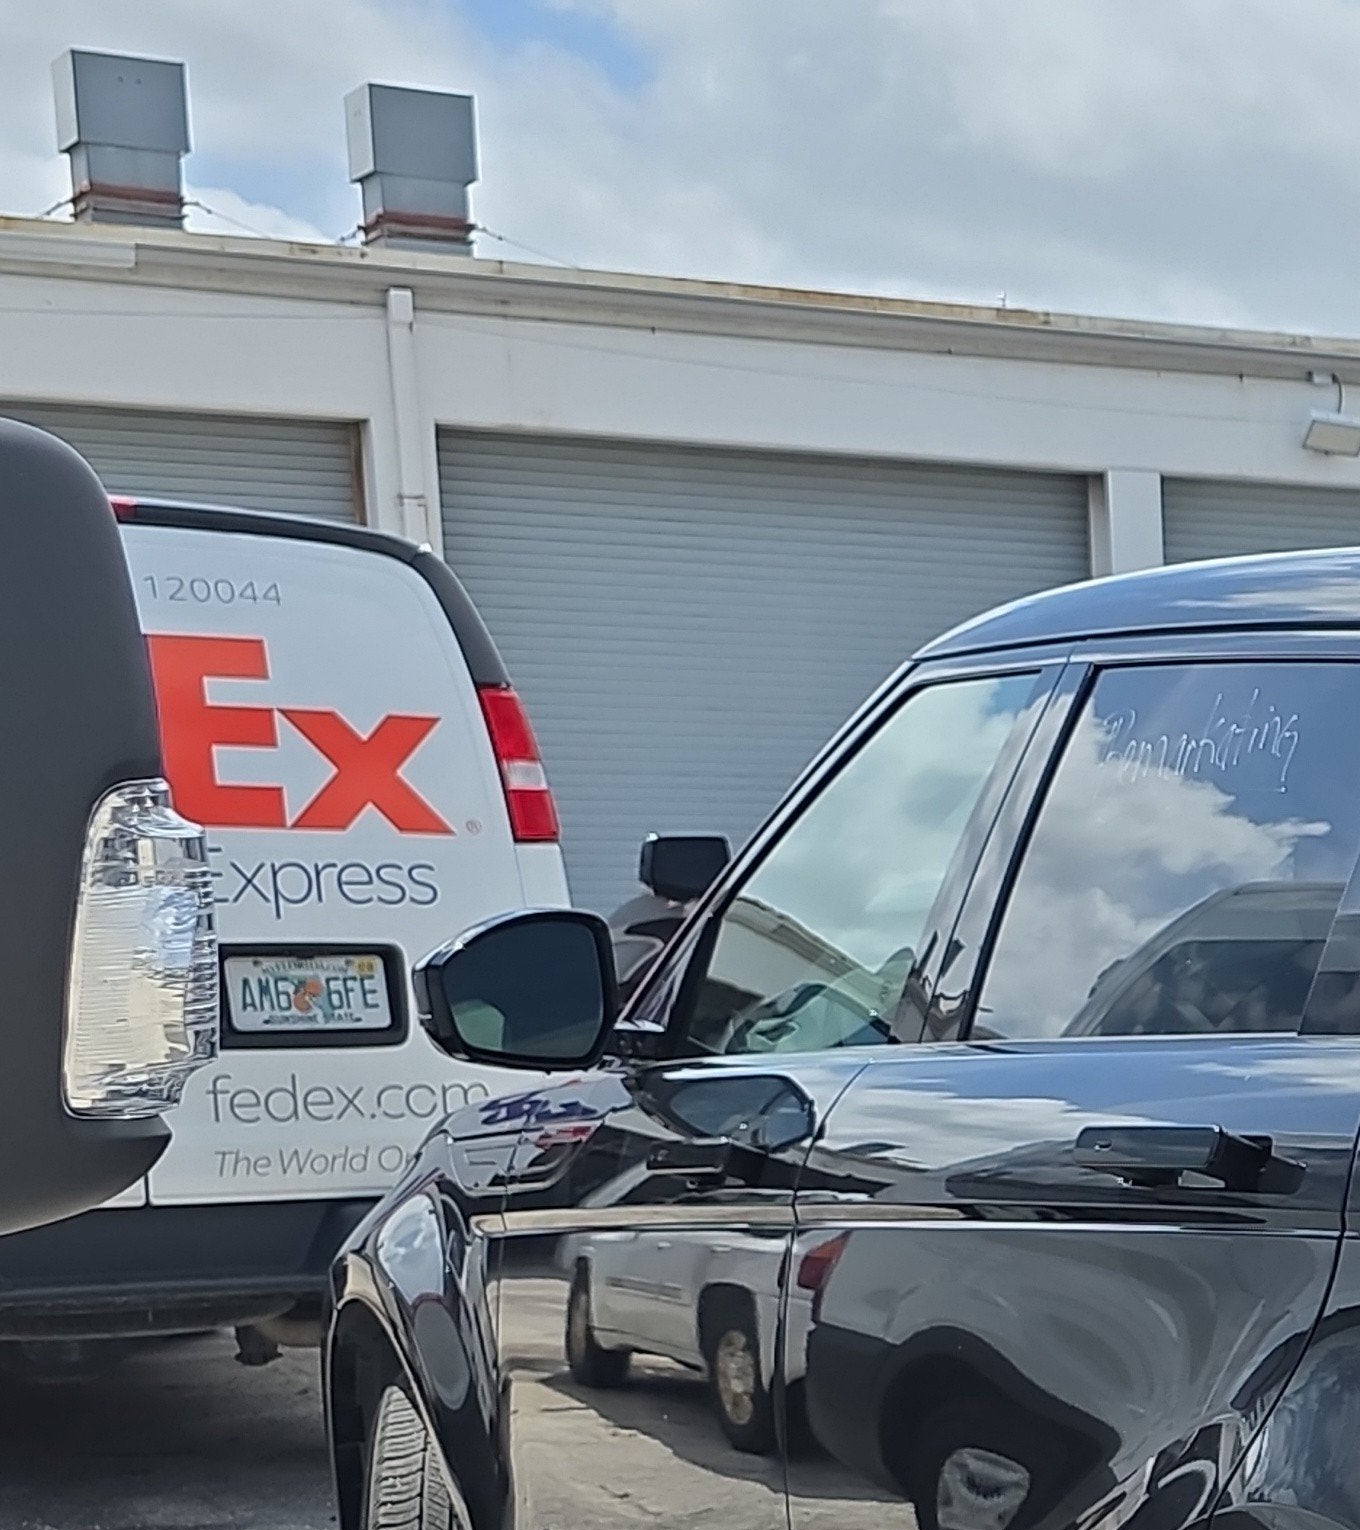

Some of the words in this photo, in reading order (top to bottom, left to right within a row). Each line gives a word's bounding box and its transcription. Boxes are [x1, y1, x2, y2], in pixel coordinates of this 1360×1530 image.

[143, 575, 282, 606] 120044
[214, 1150, 272, 1177] The
[279, 1146, 368, 1175] World
